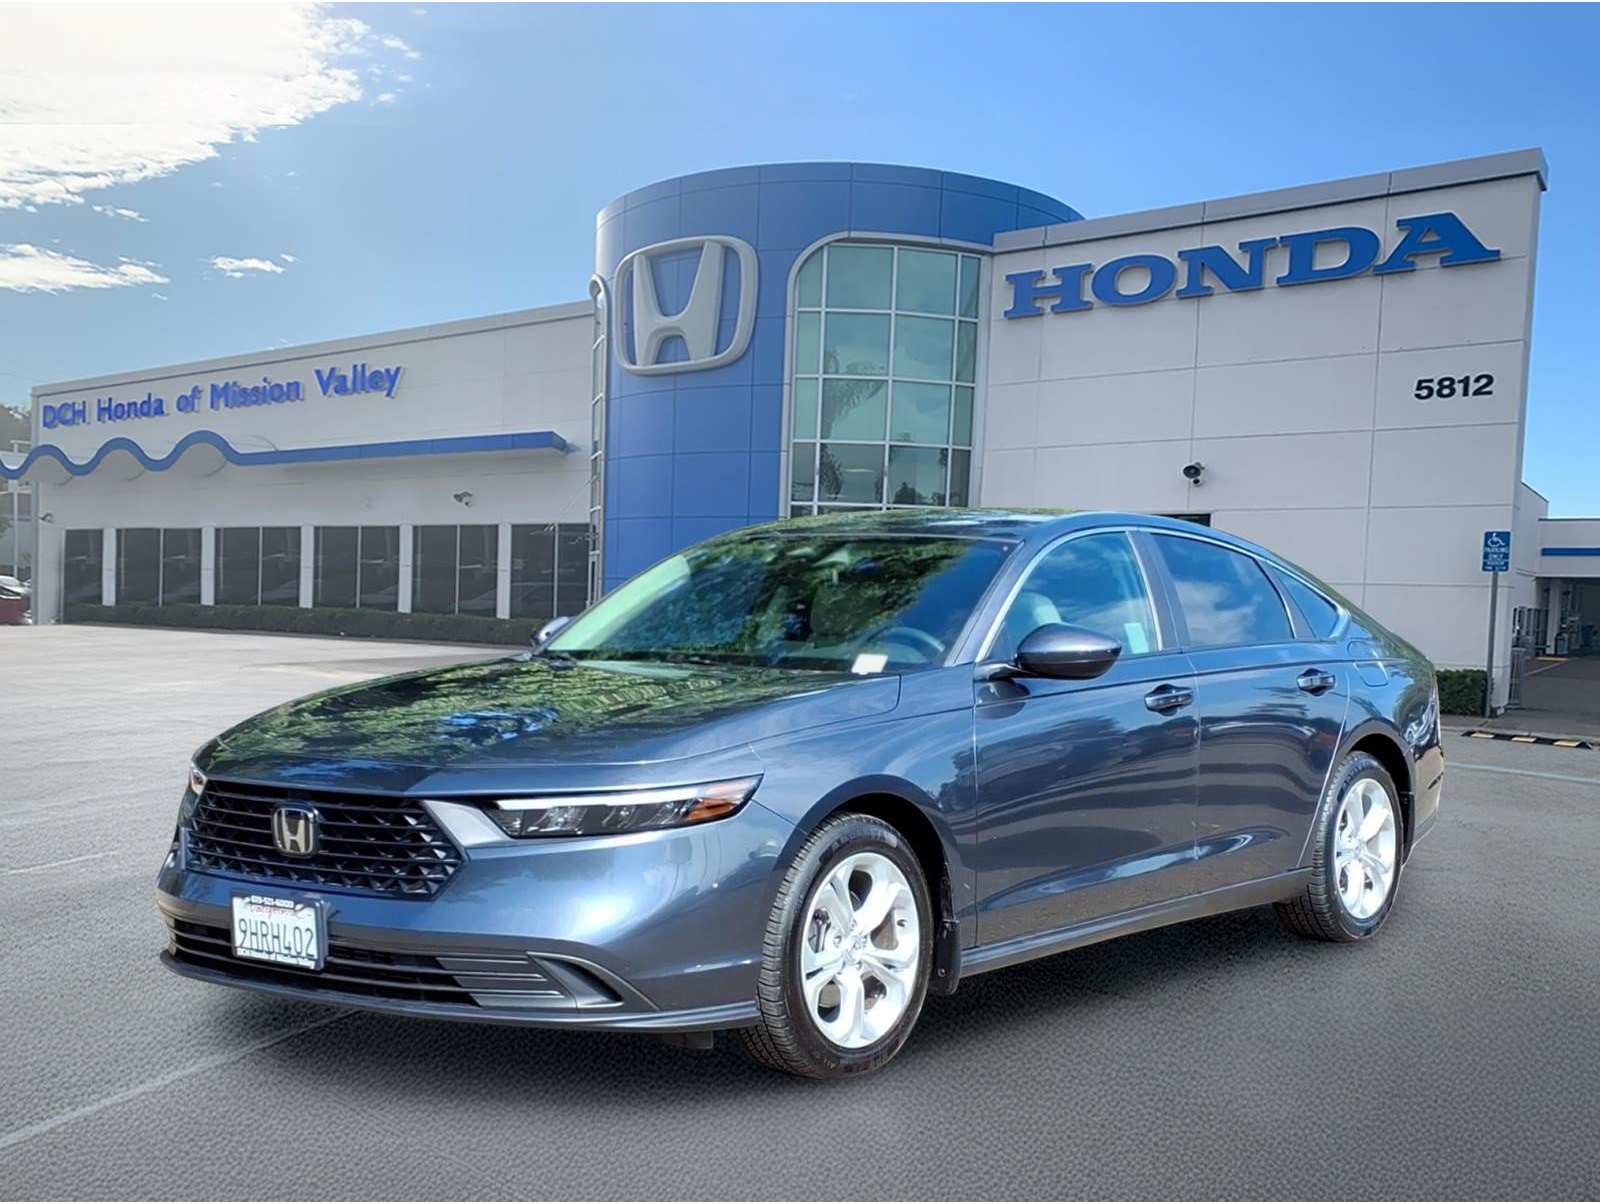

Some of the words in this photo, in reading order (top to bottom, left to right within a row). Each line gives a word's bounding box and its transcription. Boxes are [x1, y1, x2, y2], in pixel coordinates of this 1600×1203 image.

[1004, 212, 1501, 319] HONDA
[43, 401, 88, 429] DCH
[97, 392, 166, 422] Honda
[176, 385, 203, 413] of
[210, 377, 304, 410] Mission
[314, 363, 402, 399] Valley
[1414, 374, 1495, 400] 5812
[238, 918, 316, 958] 9HRH402
